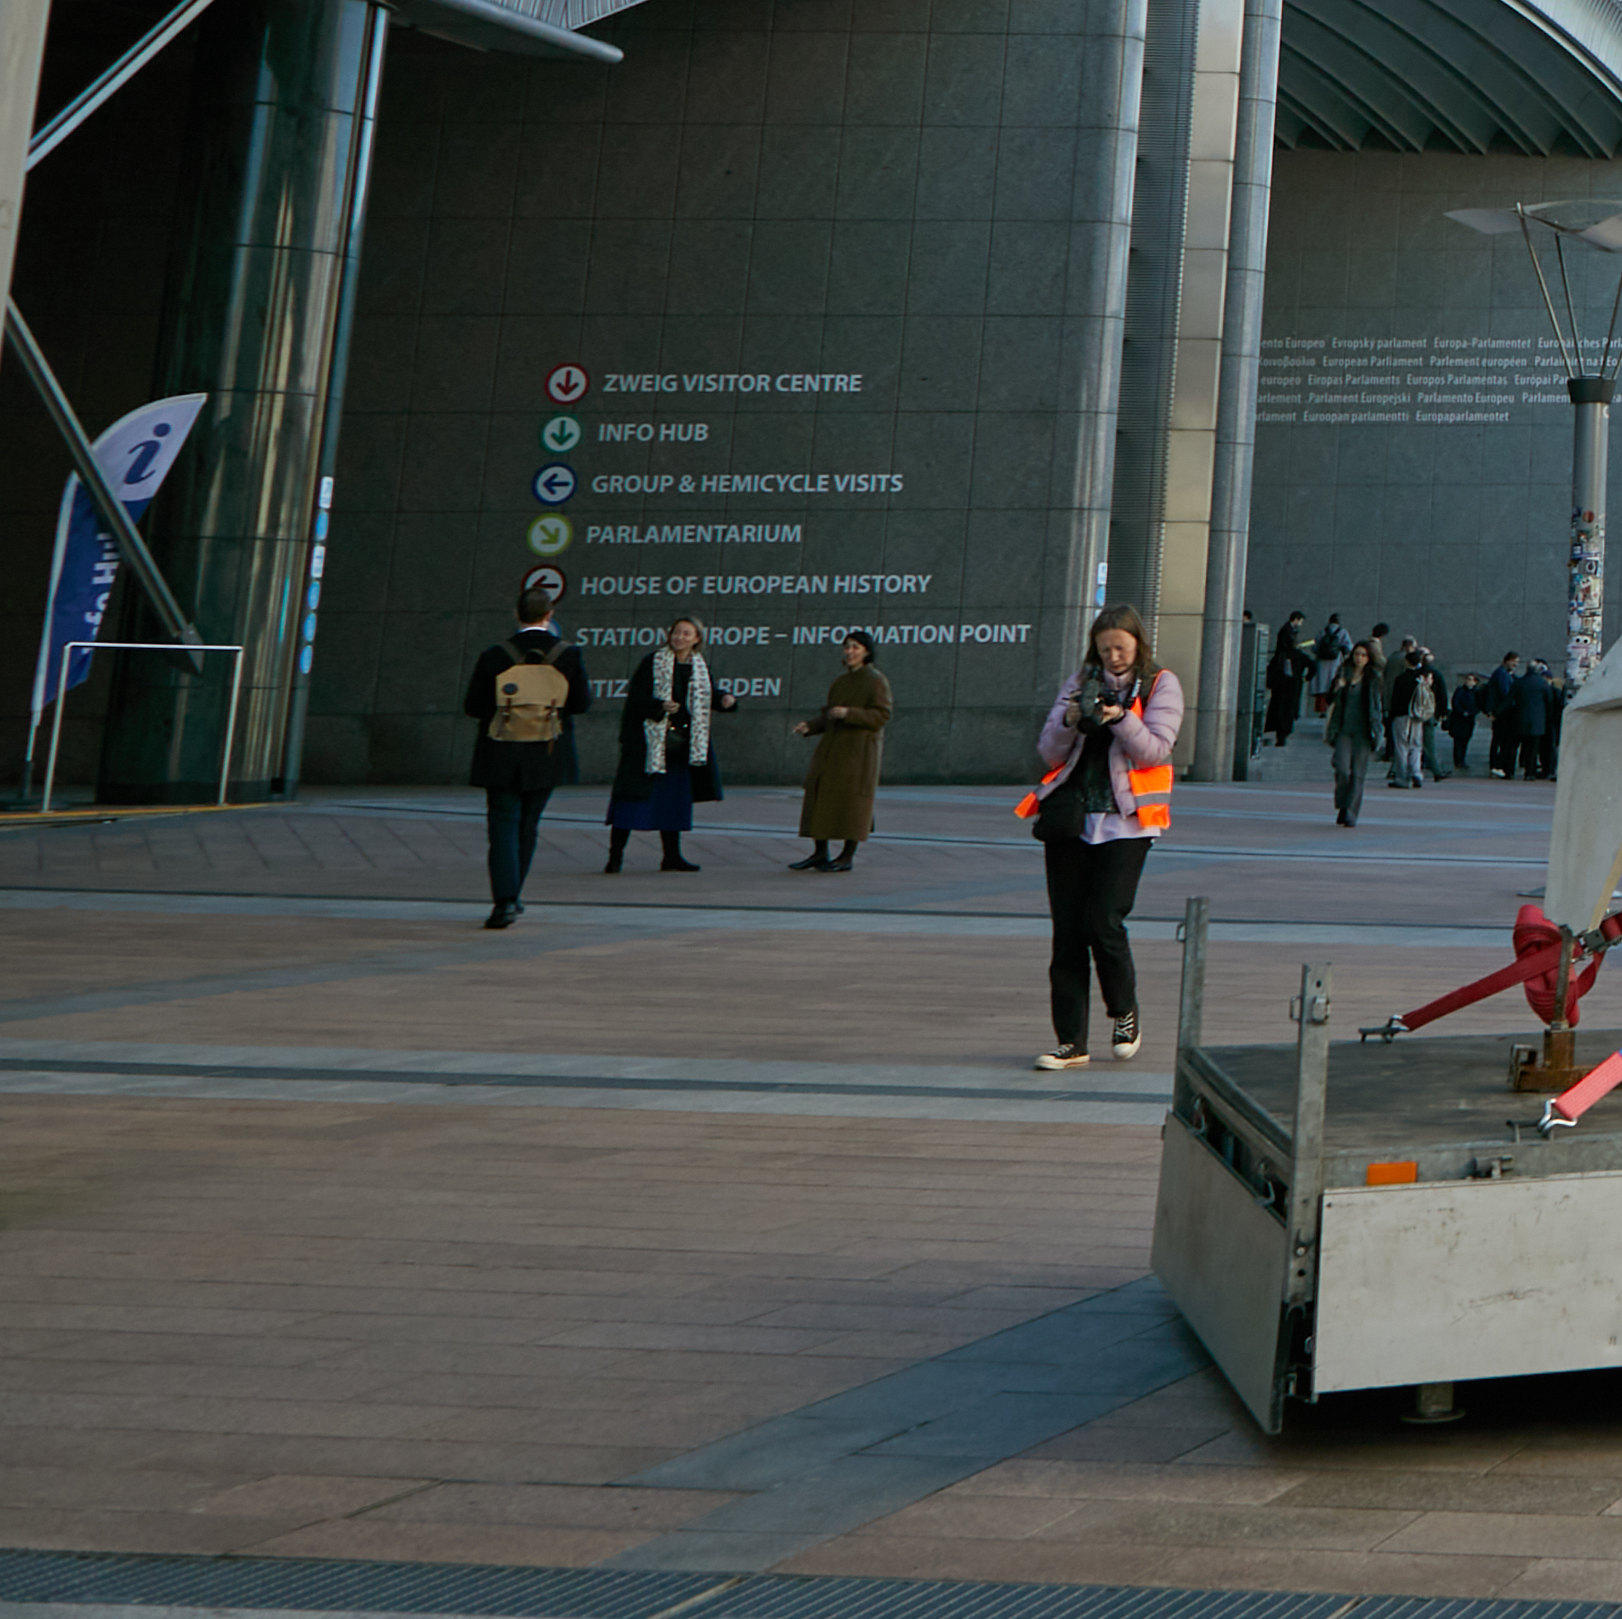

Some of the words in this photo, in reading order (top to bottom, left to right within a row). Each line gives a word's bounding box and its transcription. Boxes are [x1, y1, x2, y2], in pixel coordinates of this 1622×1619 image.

[1286, 337, 1325, 351] Europeo
[1377, 337, 1427, 351] parlament
[1434, 337, 1532, 351] Europa-Parlamentet
[1323, 356, 1369, 369] European
[1371, 356, 1423, 367] Parliament
[1430, 356, 1480, 367] Parlement
[603, 374, 679, 392] ZWEIG
[683, 373, 771, 392] VISITOR
[775, 373, 863, 392] CENTRE
[1261, 376, 1301, 388] europeo
[1308, 374, 1343, 387] Eiropas
[1345, 374, 1400, 385] Parlaments
[1407, 374, 1446, 387] Europos
[1447, 374, 1508, 386] Parlamentas
[1258, 392, 1301, 404] arlement
[1308, 392, 1359, 404] Parlament
[1361, 392, 1411, 405] Europejski
[1418, 392, 1473, 403] Parlamento
[1475, 392, 1515, 405] Europeu
[1304, 411, 1350, 424] Euroopan
[1352, 411, 1410, 424] parlamentti
[1416, 411, 1510, 424] Europaparlamentet
[598, 423, 655, 442] INFO
[659, 423, 709, 442] HUB
[591, 474, 674, 493] GROUP
[679, 474, 697, 493] &
[701, 474, 831, 493] HEMICYCLE
[834, 473, 904, 492] VISITS
[586, 524, 802, 544] PARLAMENTARIUM
[580, 576, 662, 595] HOUSE
[666, 575, 699, 594] OF
[702, 575, 829, 594] EUROPEAN
[833, 574, 932, 593] HISTORY
[959, 623, 1032, 643] POINT
